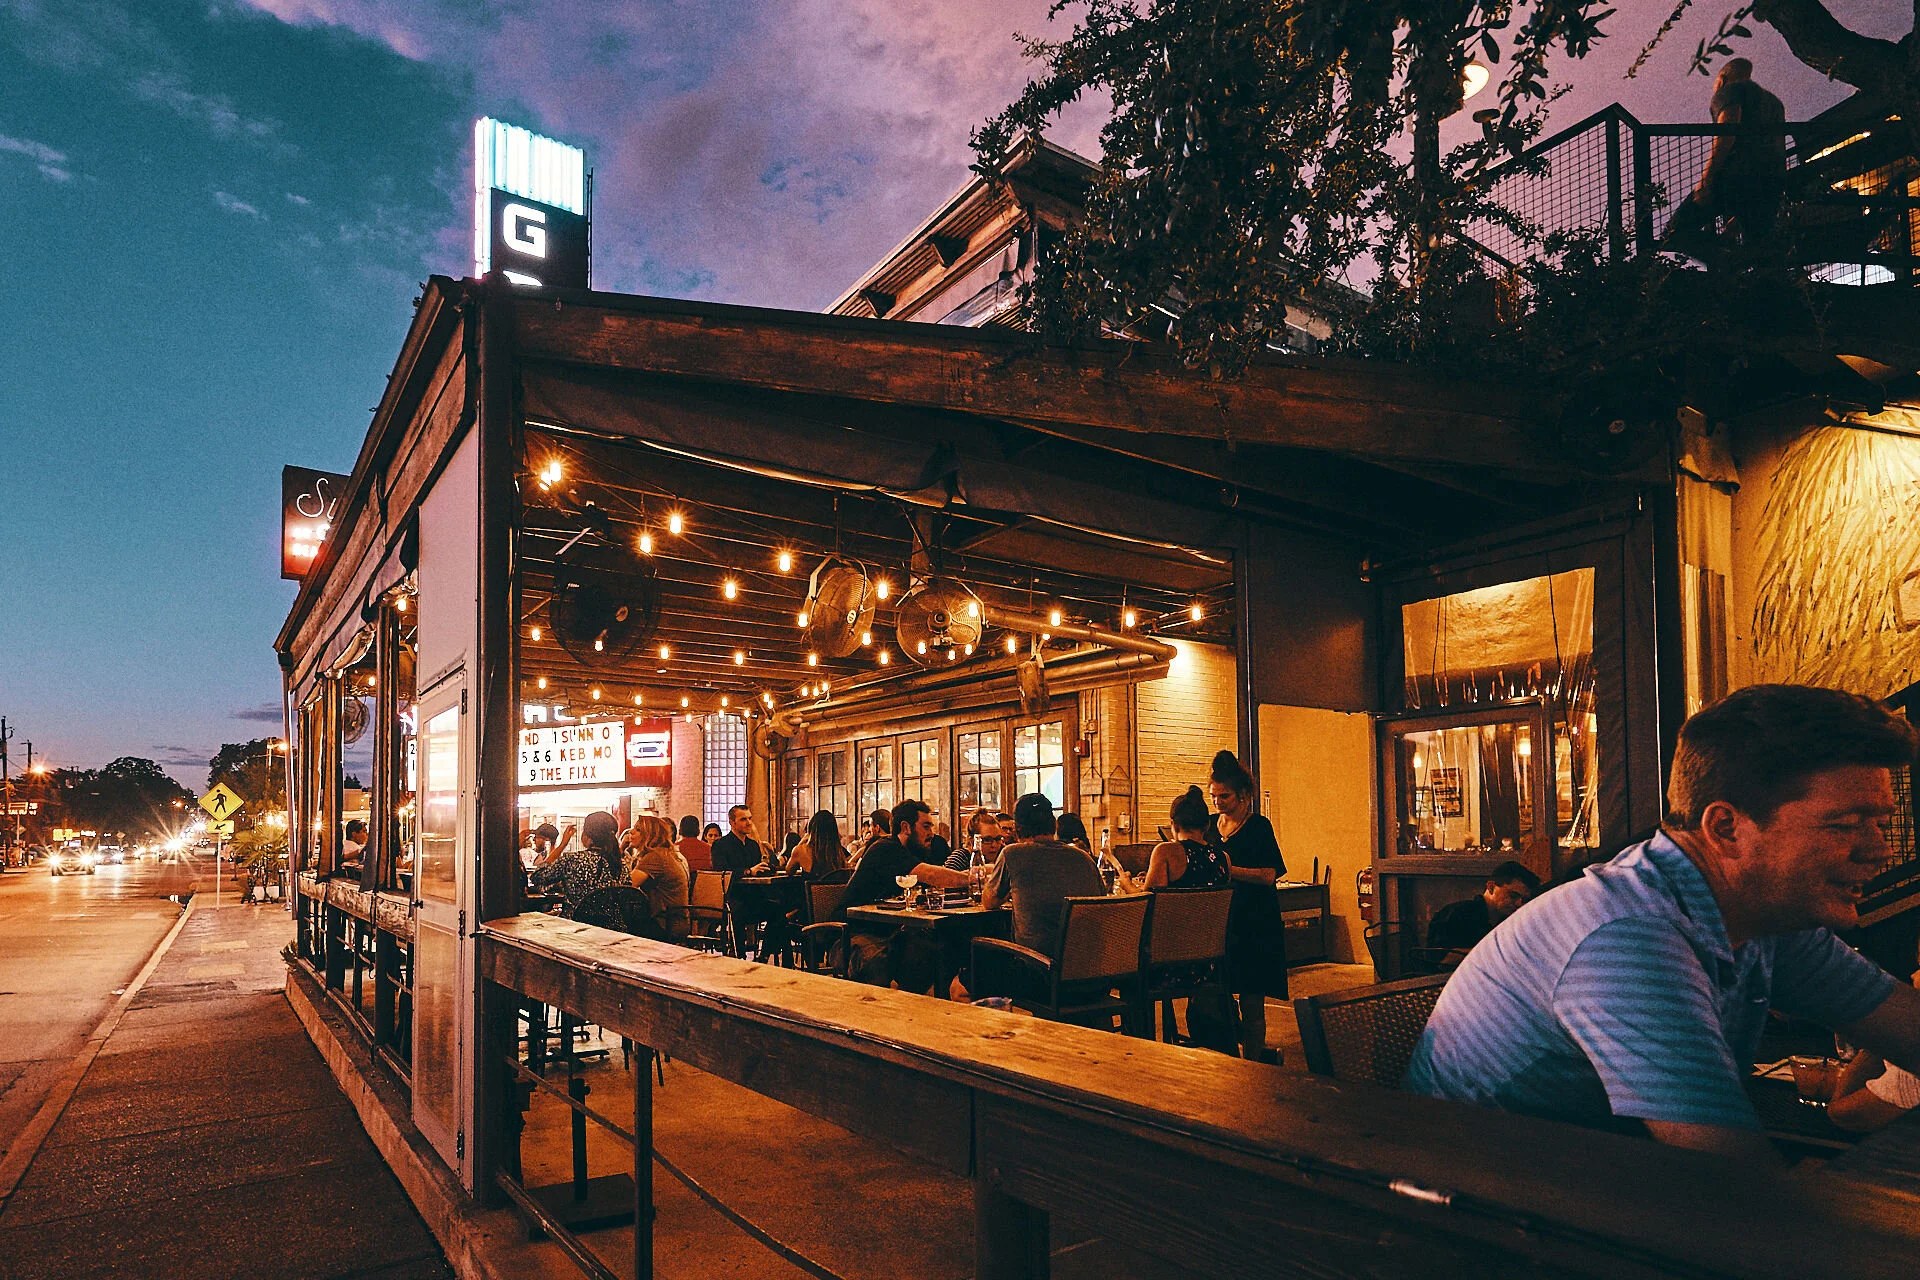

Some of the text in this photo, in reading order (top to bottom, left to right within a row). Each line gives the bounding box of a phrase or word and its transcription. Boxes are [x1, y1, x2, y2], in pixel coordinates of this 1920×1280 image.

[503, 203, 546, 286] G
[544, 750, 551, 763] 6
[560, 747, 586, 762] KEB
[593, 746, 612, 759] MO
[530, 766, 597, 781] 9 THE FIXX
